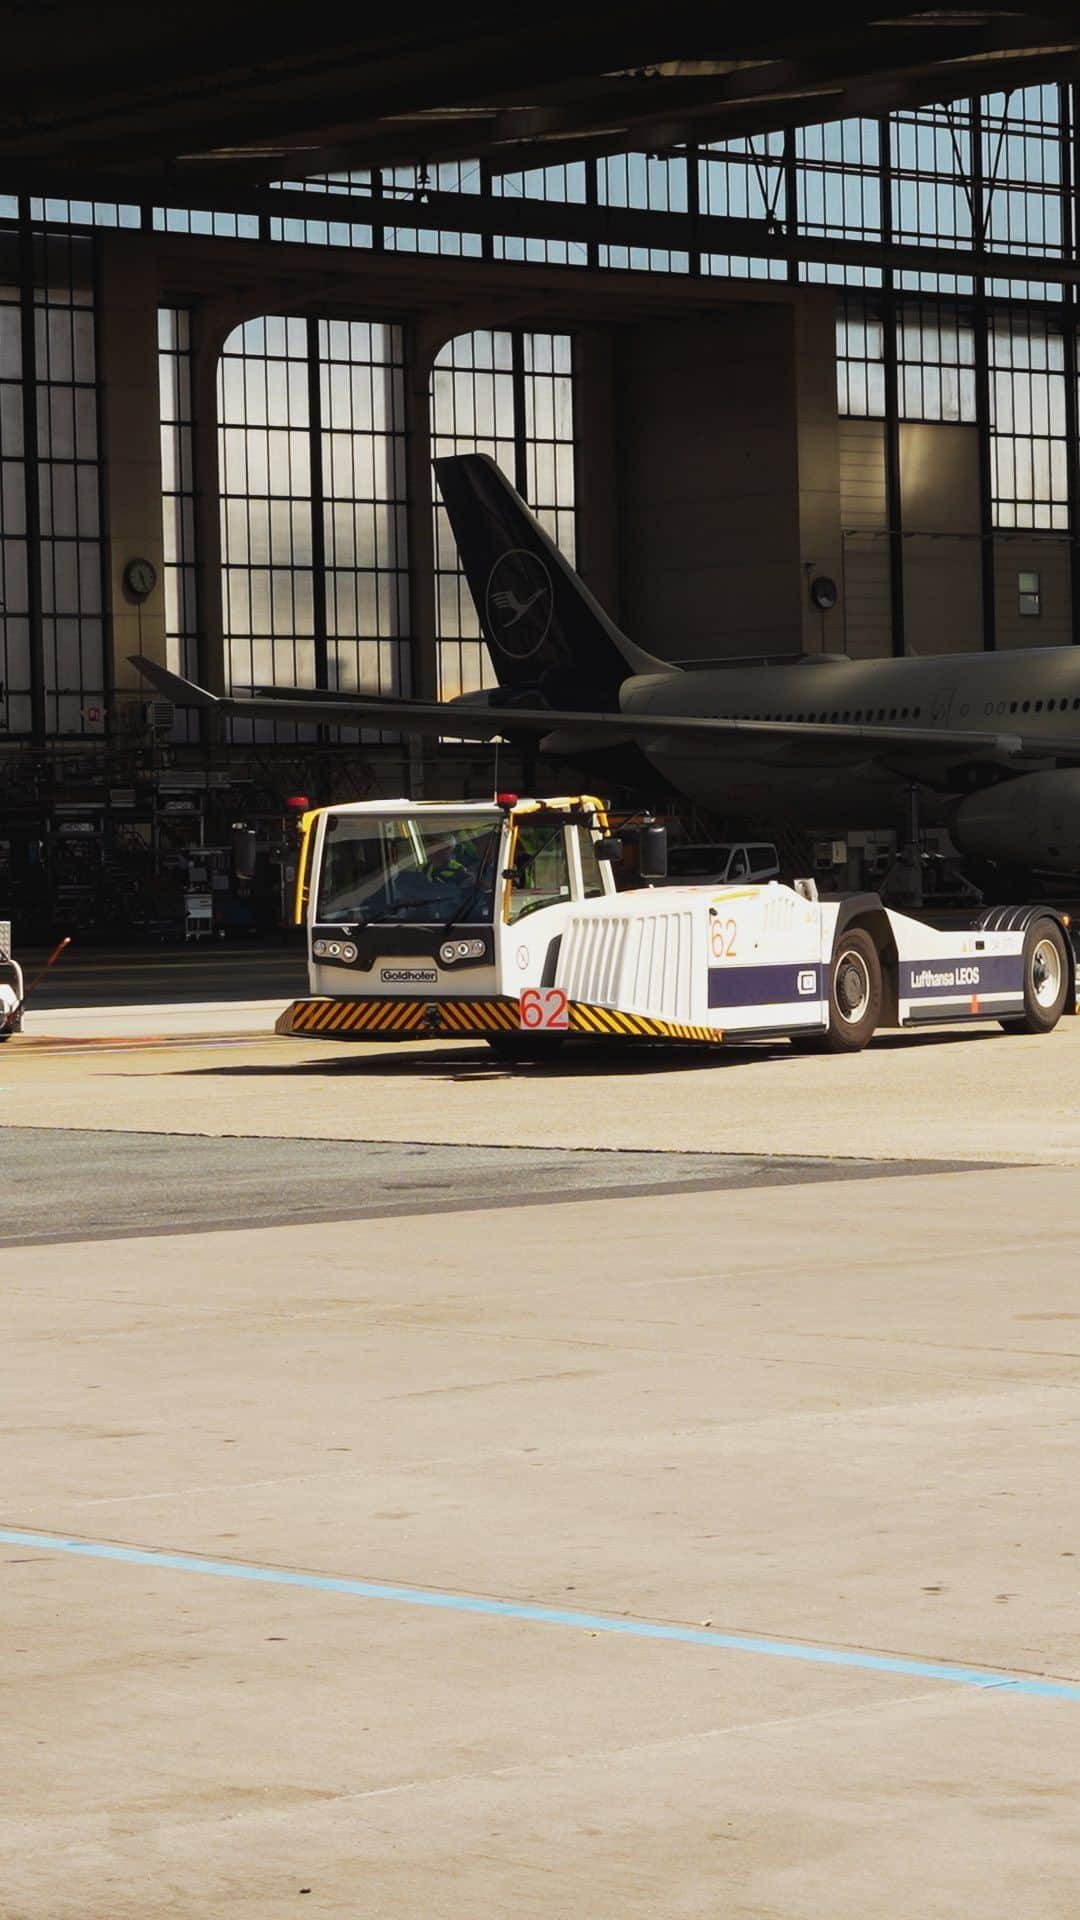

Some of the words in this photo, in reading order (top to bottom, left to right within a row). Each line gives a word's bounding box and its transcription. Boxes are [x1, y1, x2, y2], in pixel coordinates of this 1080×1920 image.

[711, 918, 737, 957] 62
[383, 970, 435, 980] Goldhofer
[910, 970, 954, 988] Lufthansa
[955, 967, 980, 986] LEOS
[520, 989, 569, 1028] 62
